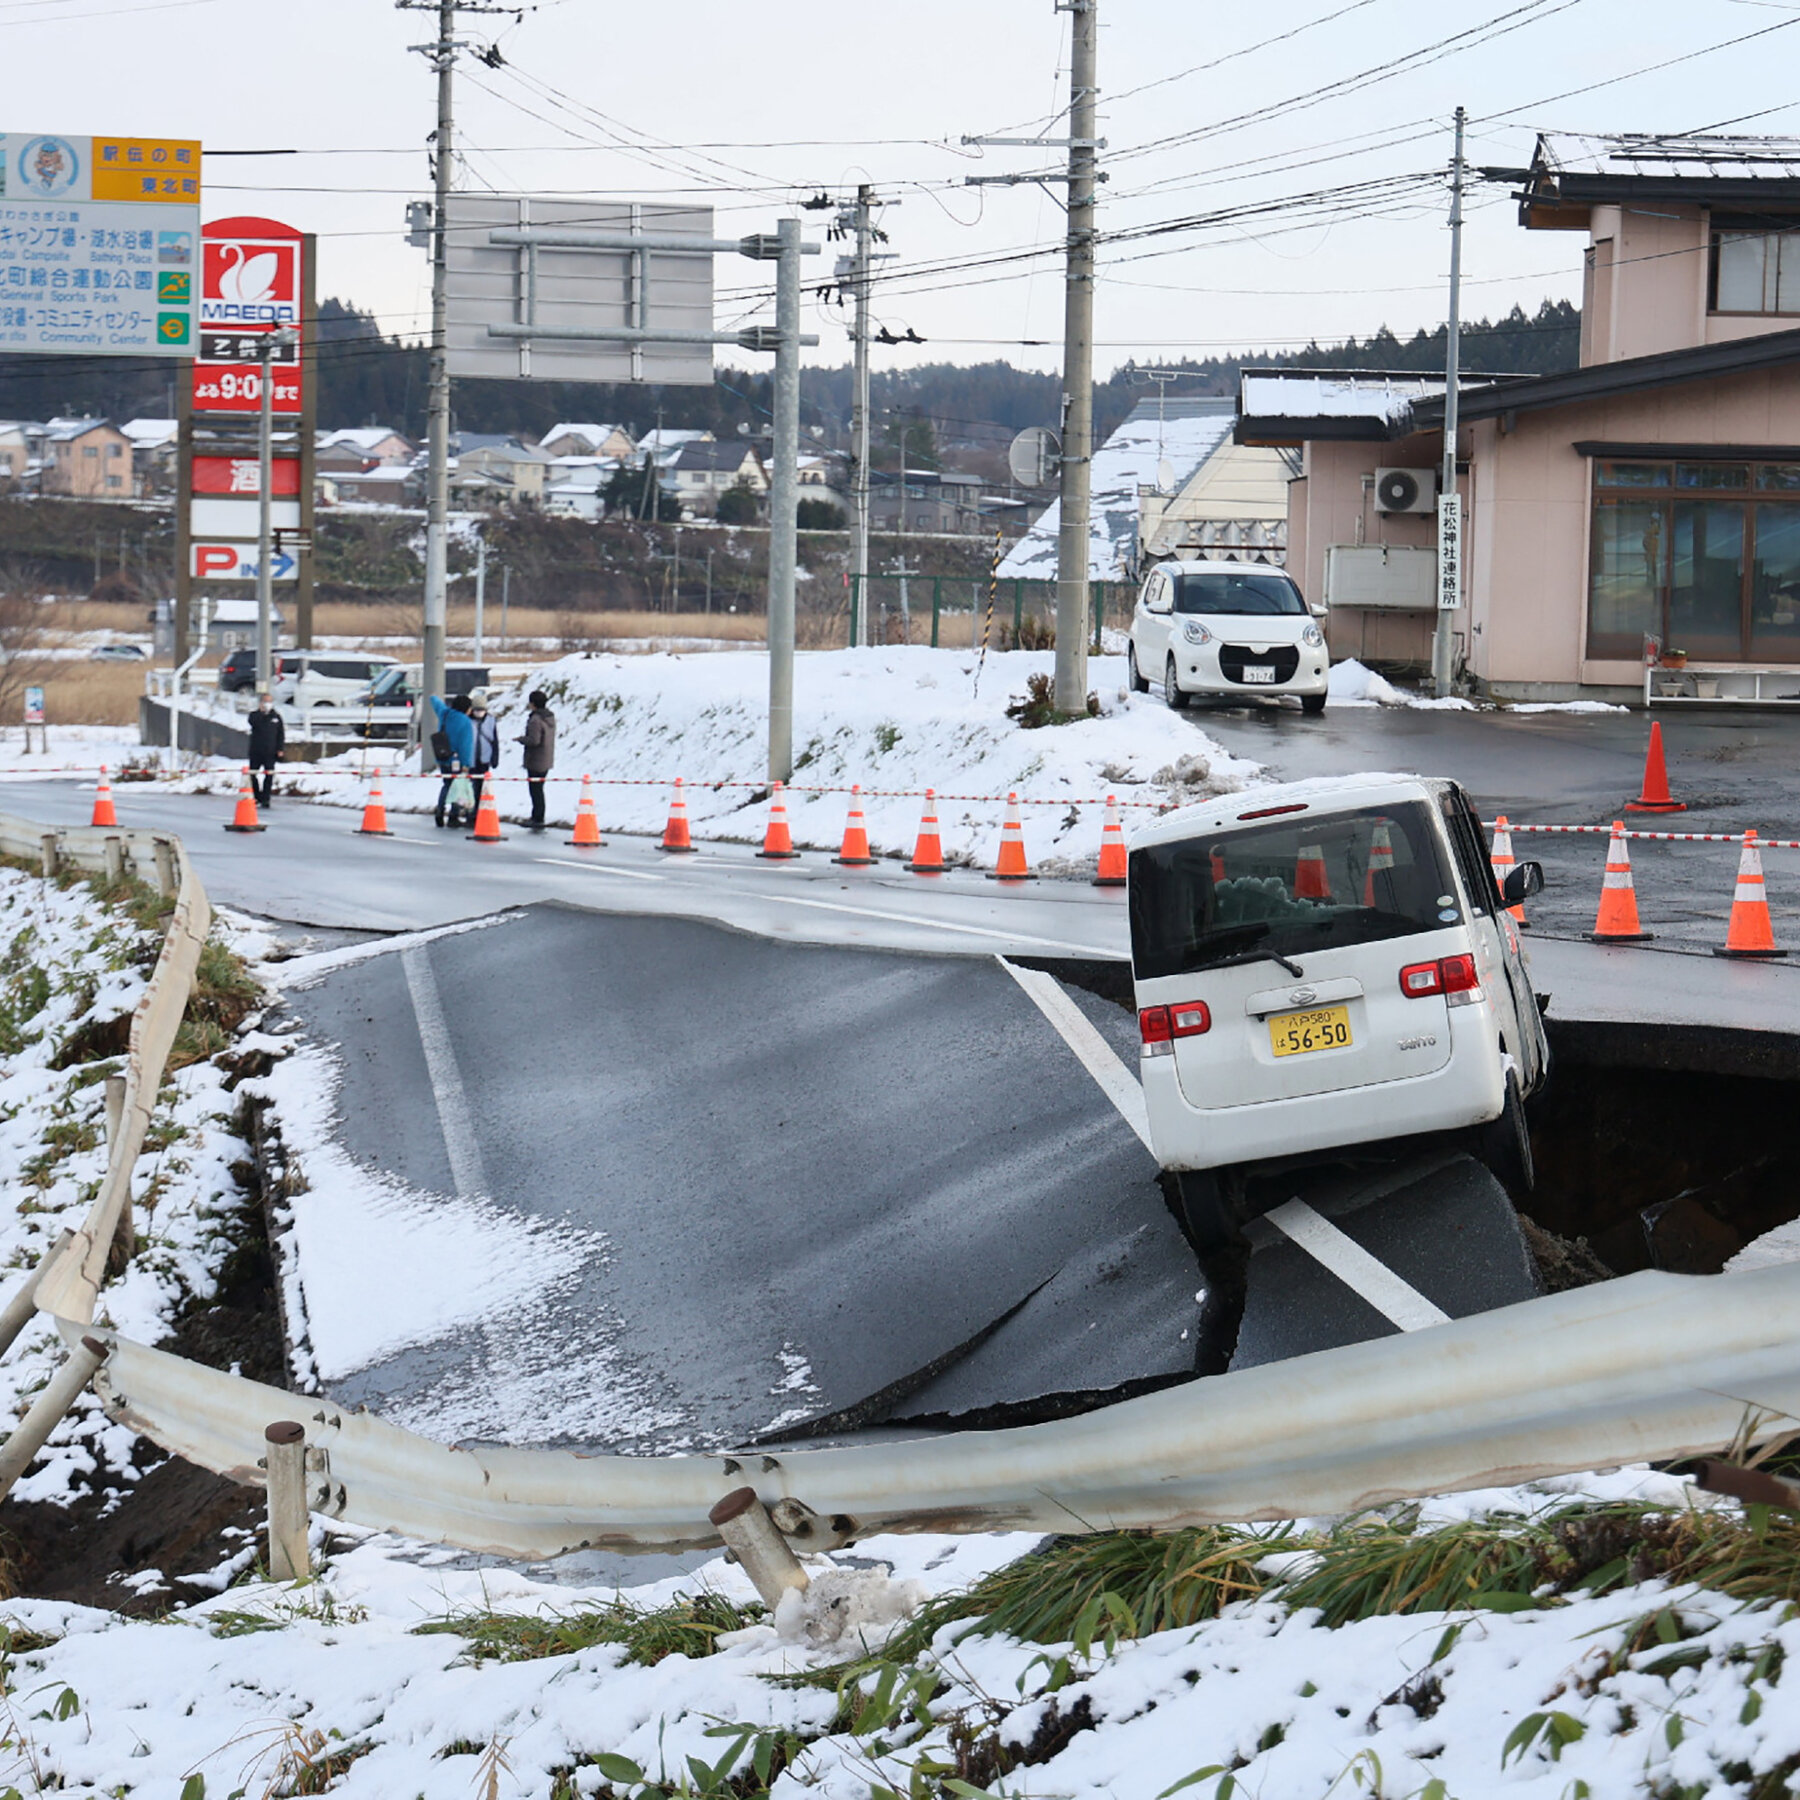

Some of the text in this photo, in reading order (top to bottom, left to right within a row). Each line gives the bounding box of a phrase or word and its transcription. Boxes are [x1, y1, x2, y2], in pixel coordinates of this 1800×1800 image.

[141, 177, 197, 194] 東北町
[0, 210, 79, 222] わかさぎ公園
[51, 290, 87, 303] Sports
[93, 292, 118, 303] Park
[202, 303, 293, 321] MAEDA
[40, 331, 102, 344] Community
[109, 333, 148, 344] Center
[230, 459, 261, 492] 酒
[196, 546, 238, 577] P
[1443, 502, 1456, 604] 花松神社連絡所
[1288, 1023, 1347, 1051] 56-50
